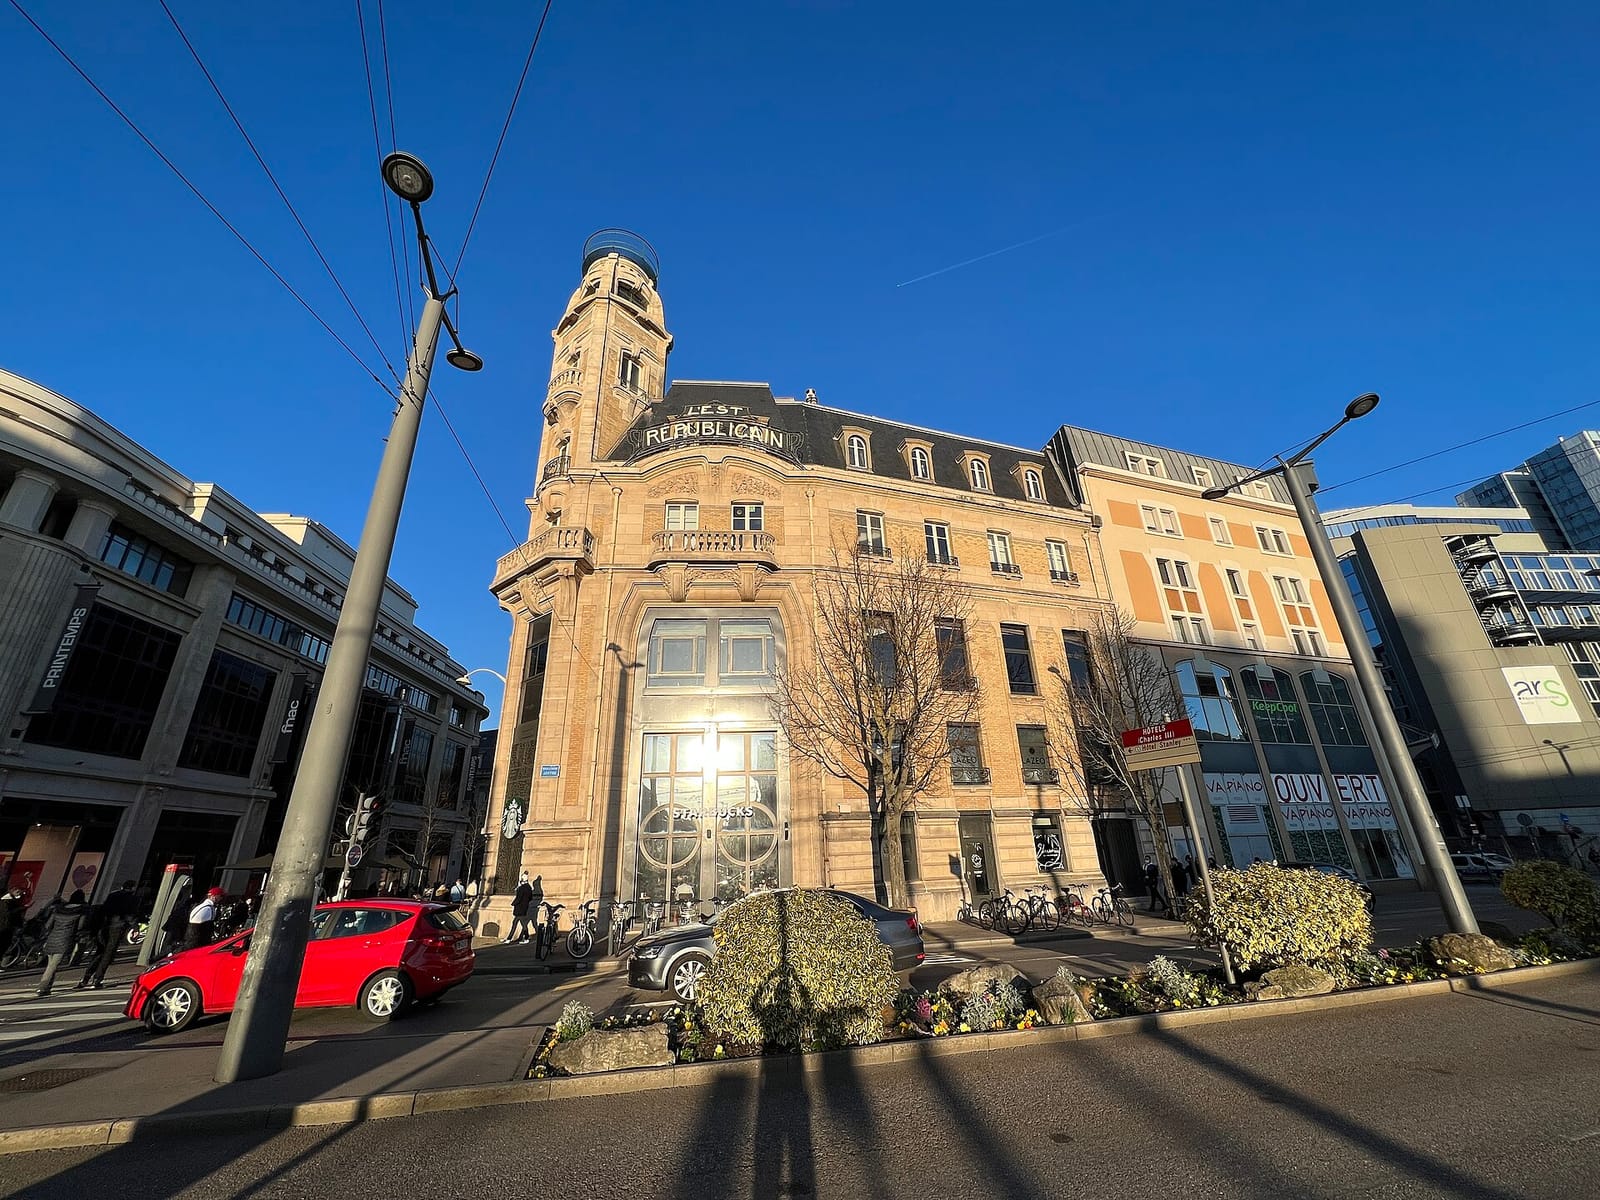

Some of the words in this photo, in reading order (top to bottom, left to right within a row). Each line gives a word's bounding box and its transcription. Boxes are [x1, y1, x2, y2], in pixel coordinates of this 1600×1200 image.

[688, 405, 743, 415] L'EST
[42, 607, 87, 688] PRINTEMPS
[281, 700, 299, 734] fnac
[1252, 700, 1298, 714] KeepCool
[1274, 774, 1381, 803] OUVERT
[672, 806, 755, 820] STARBUCKS
